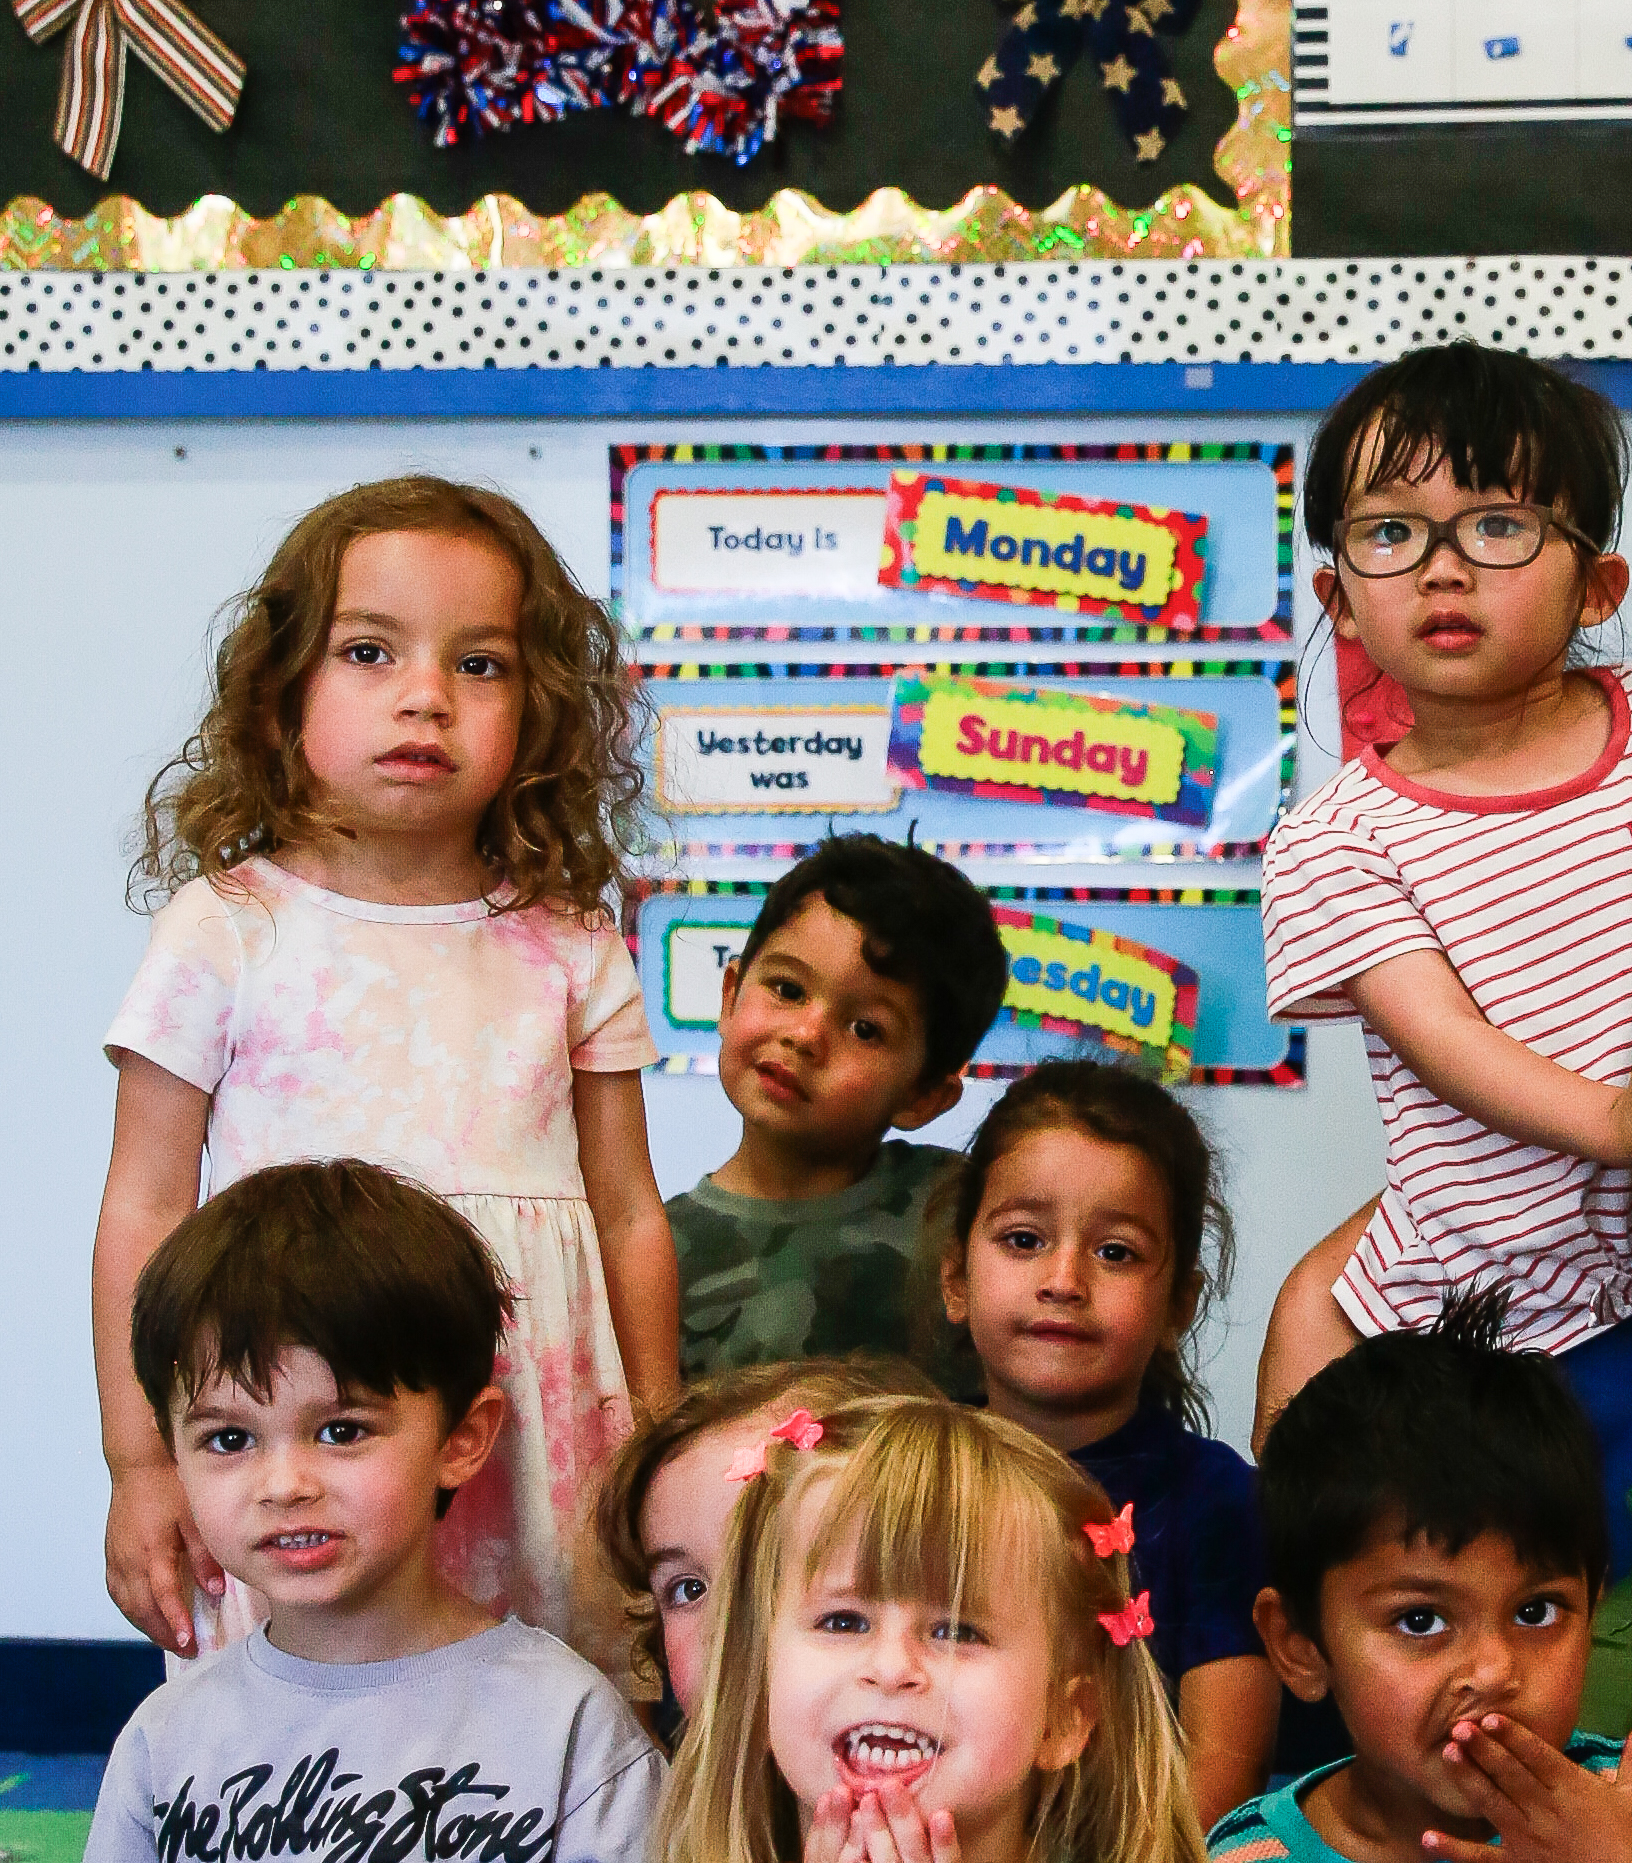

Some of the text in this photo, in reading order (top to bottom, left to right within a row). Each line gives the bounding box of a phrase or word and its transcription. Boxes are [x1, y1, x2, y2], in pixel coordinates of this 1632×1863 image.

[707, 526, 838, 557] Today is
[943, 516, 1148, 593] Monday
[696, 729, 864, 761] Yesterday
[955, 714, 1150, 787] Sunday
[750, 770, 811, 792] was
[1004, 951, 1156, 1028] esday
